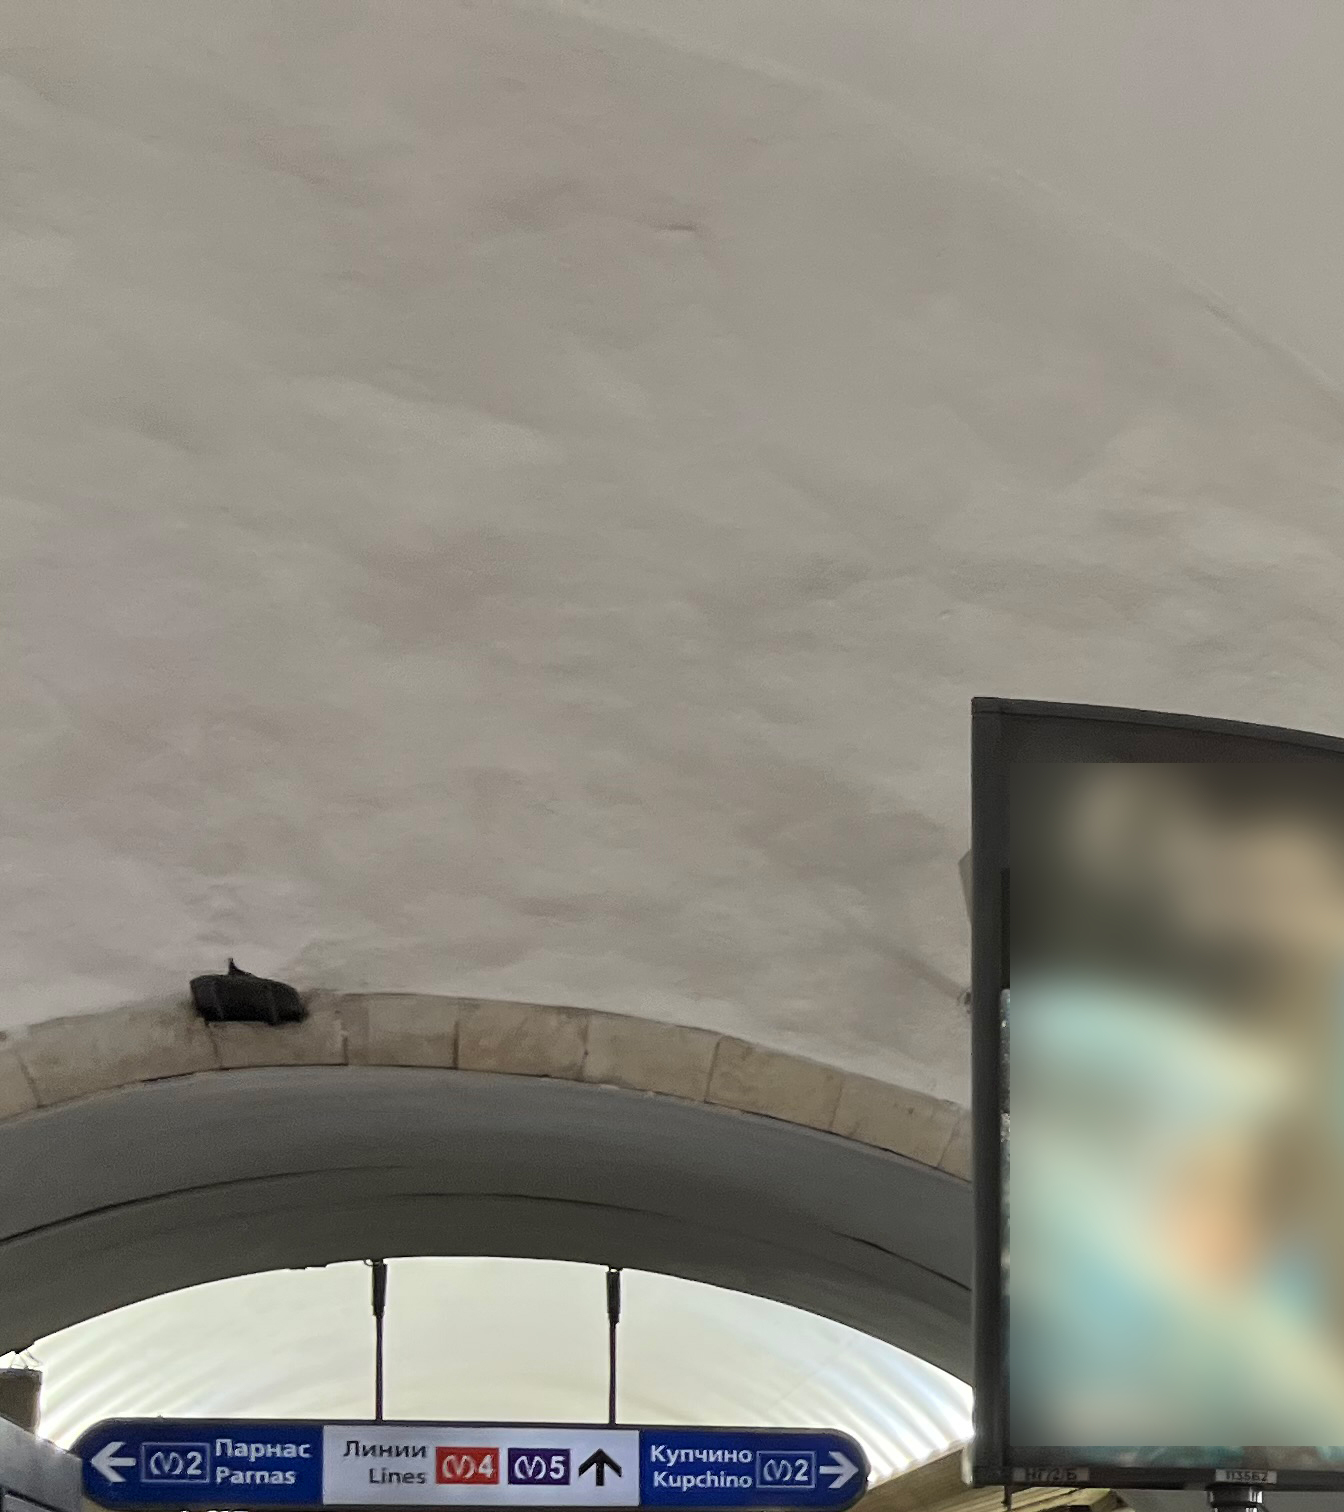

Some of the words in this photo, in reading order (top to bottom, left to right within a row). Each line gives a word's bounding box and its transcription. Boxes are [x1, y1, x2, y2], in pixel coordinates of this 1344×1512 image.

[215, 1438, 311, 1461] Парнас
[342, 1440, 427, 1458] Линии
[650, 1445, 753, 1467] Купчино
[216, 1466, 296, 1485] Parnas
[369, 1468, 427, 1485] Lines
[653, 1472, 753, 1492] Kupchino
